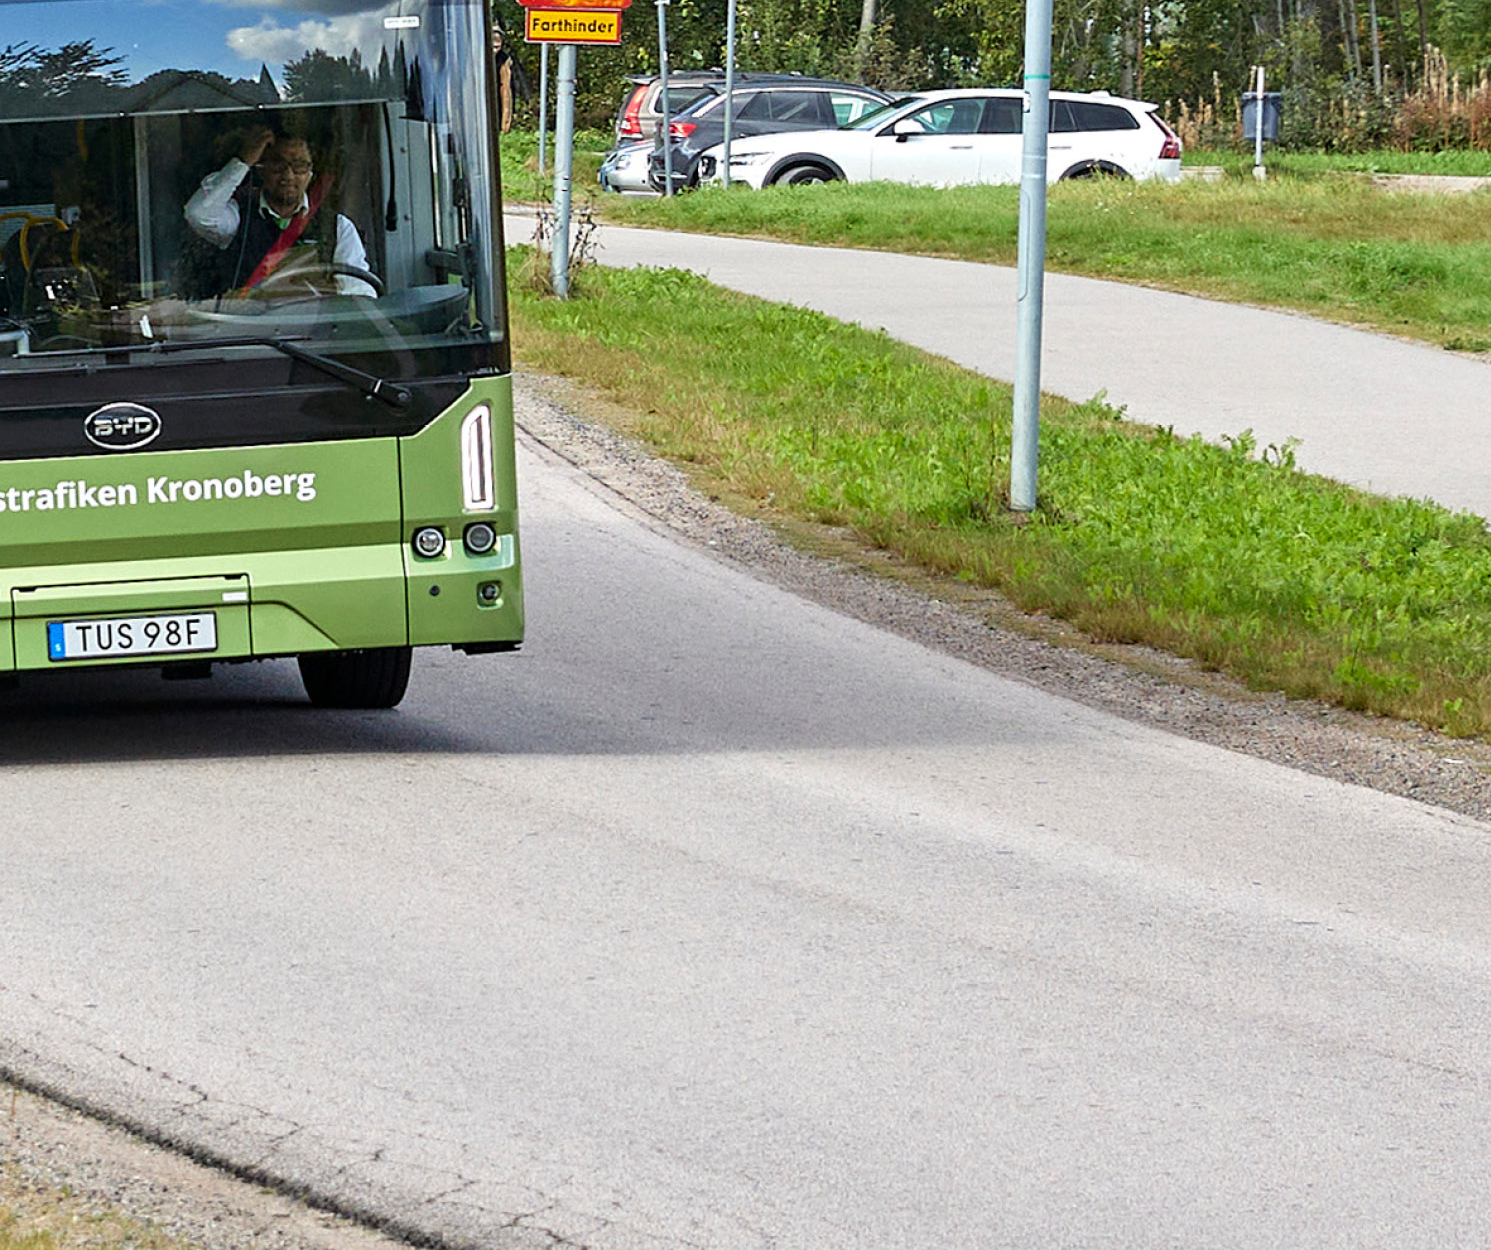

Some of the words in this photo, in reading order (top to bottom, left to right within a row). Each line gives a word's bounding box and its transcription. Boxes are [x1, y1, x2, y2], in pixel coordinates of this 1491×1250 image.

[532, 17, 614, 33] Farthinder
[93, 416, 153, 437] BYD
[146, 469, 317, 501] Kronoberg
[75, 623, 134, 652] TUS
[143, 618, 201, 648] 98F
